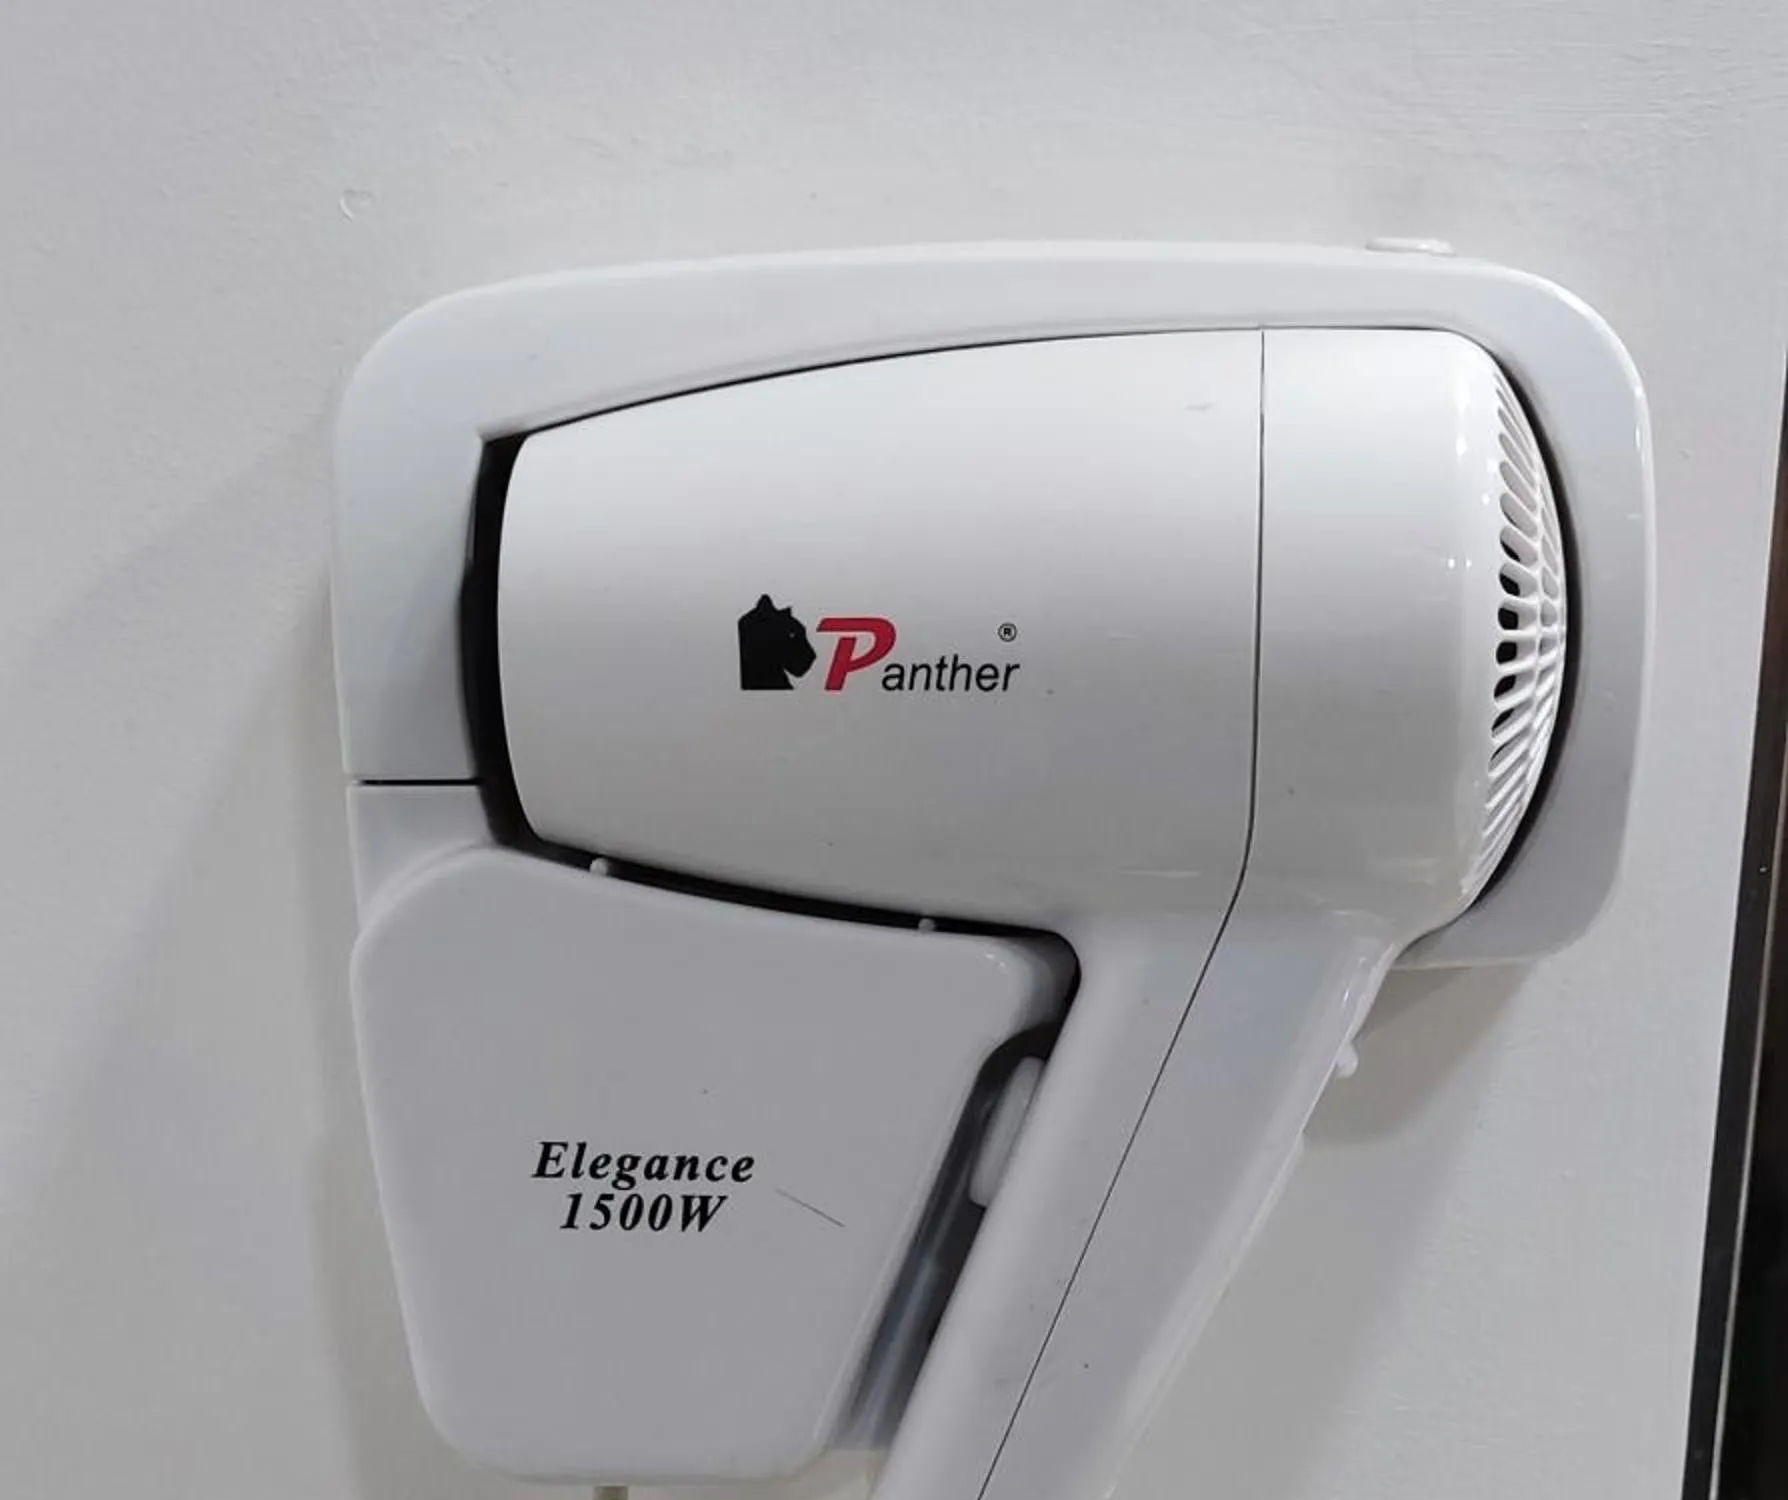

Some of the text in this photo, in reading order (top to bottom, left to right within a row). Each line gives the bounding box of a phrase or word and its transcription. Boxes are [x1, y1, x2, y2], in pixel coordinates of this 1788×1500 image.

[815, 617, 1021, 691] Panther
[531, 1140, 755, 1191] Elegance
[559, 1192, 729, 1232] 1500W
